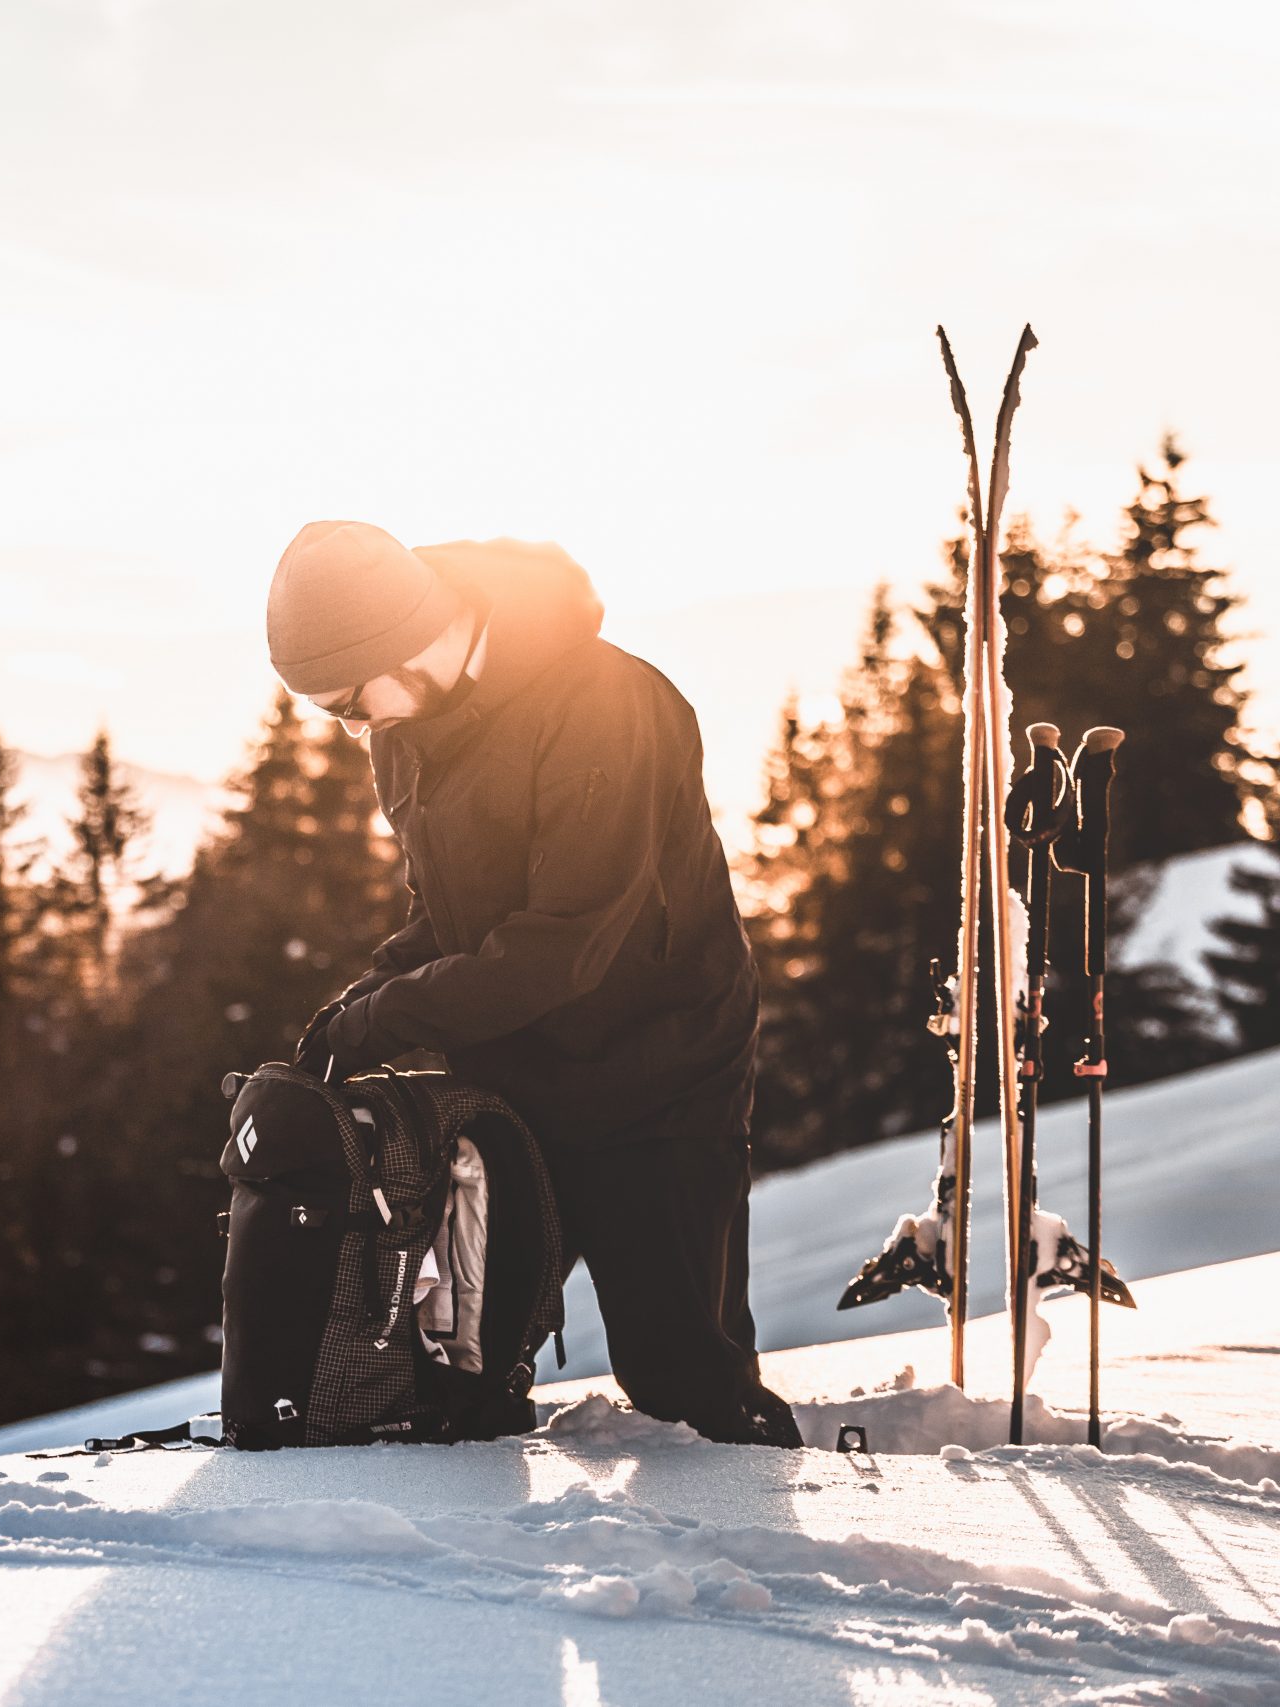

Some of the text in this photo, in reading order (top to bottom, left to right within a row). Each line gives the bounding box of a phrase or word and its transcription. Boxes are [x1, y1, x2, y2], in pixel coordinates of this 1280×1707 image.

[382, 1251, 408, 1336] Black Diamond
[401, 1421, 412, 1431] 25
